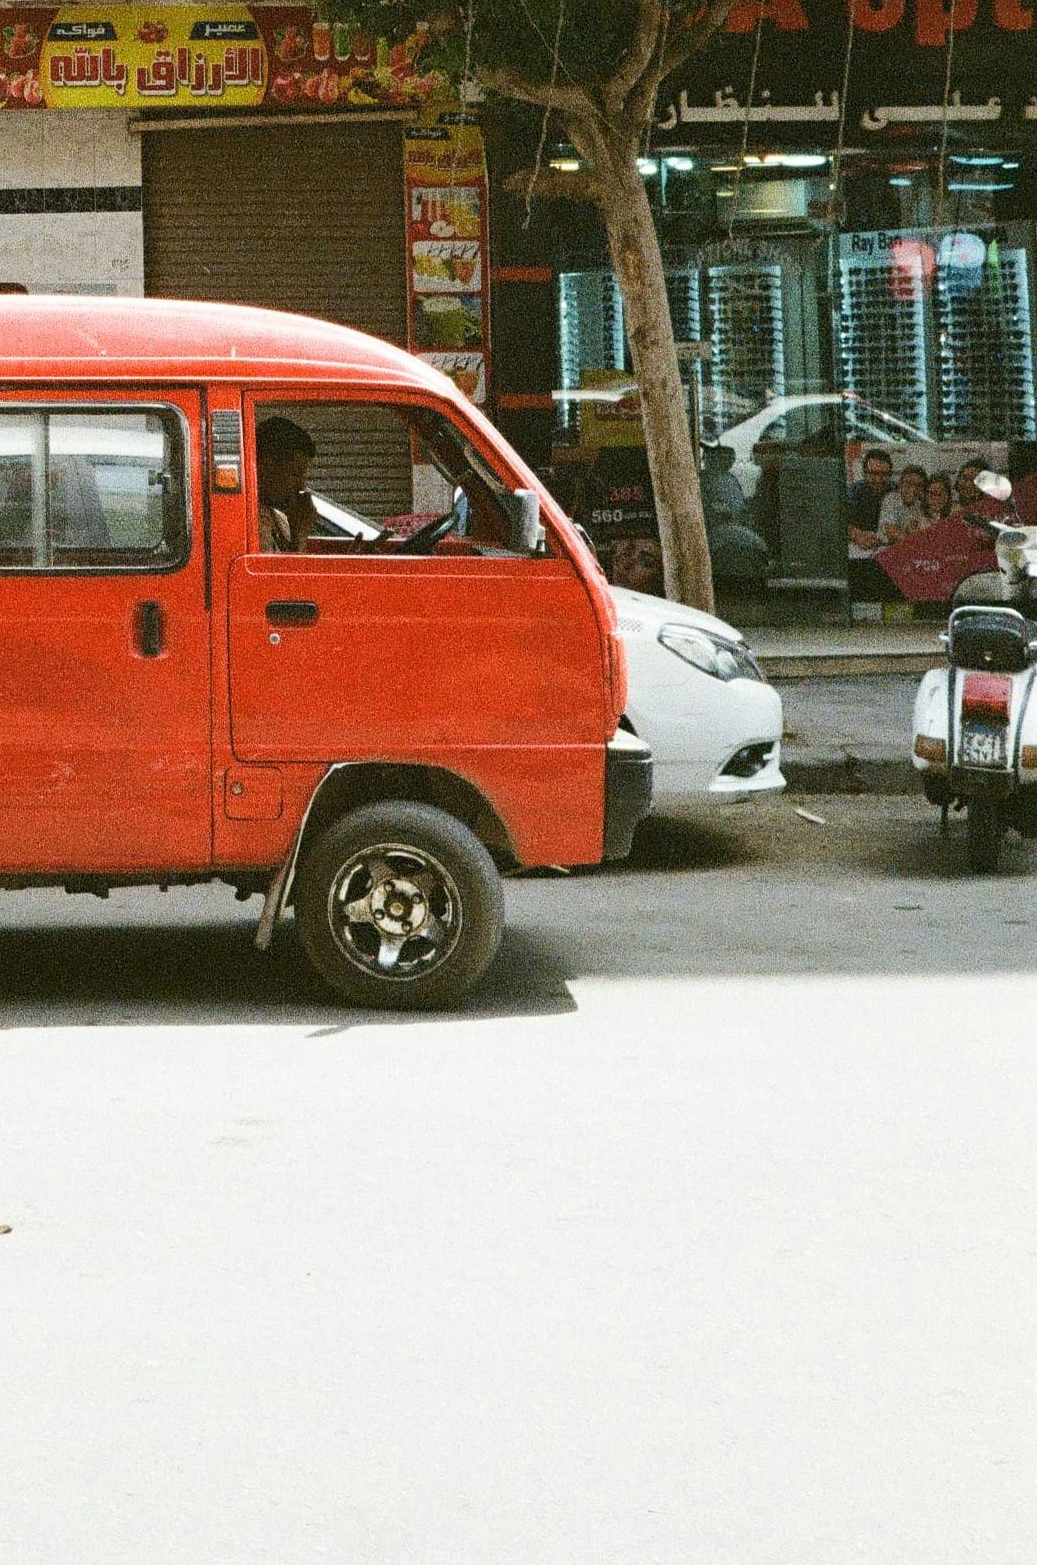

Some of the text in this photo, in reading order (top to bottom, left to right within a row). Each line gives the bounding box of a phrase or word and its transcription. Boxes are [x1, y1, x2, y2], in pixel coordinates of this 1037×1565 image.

[204, 23, 245, 36] عصير
[49, 47, 127, 96] بالله
[852, 234, 874, 256] Ray
